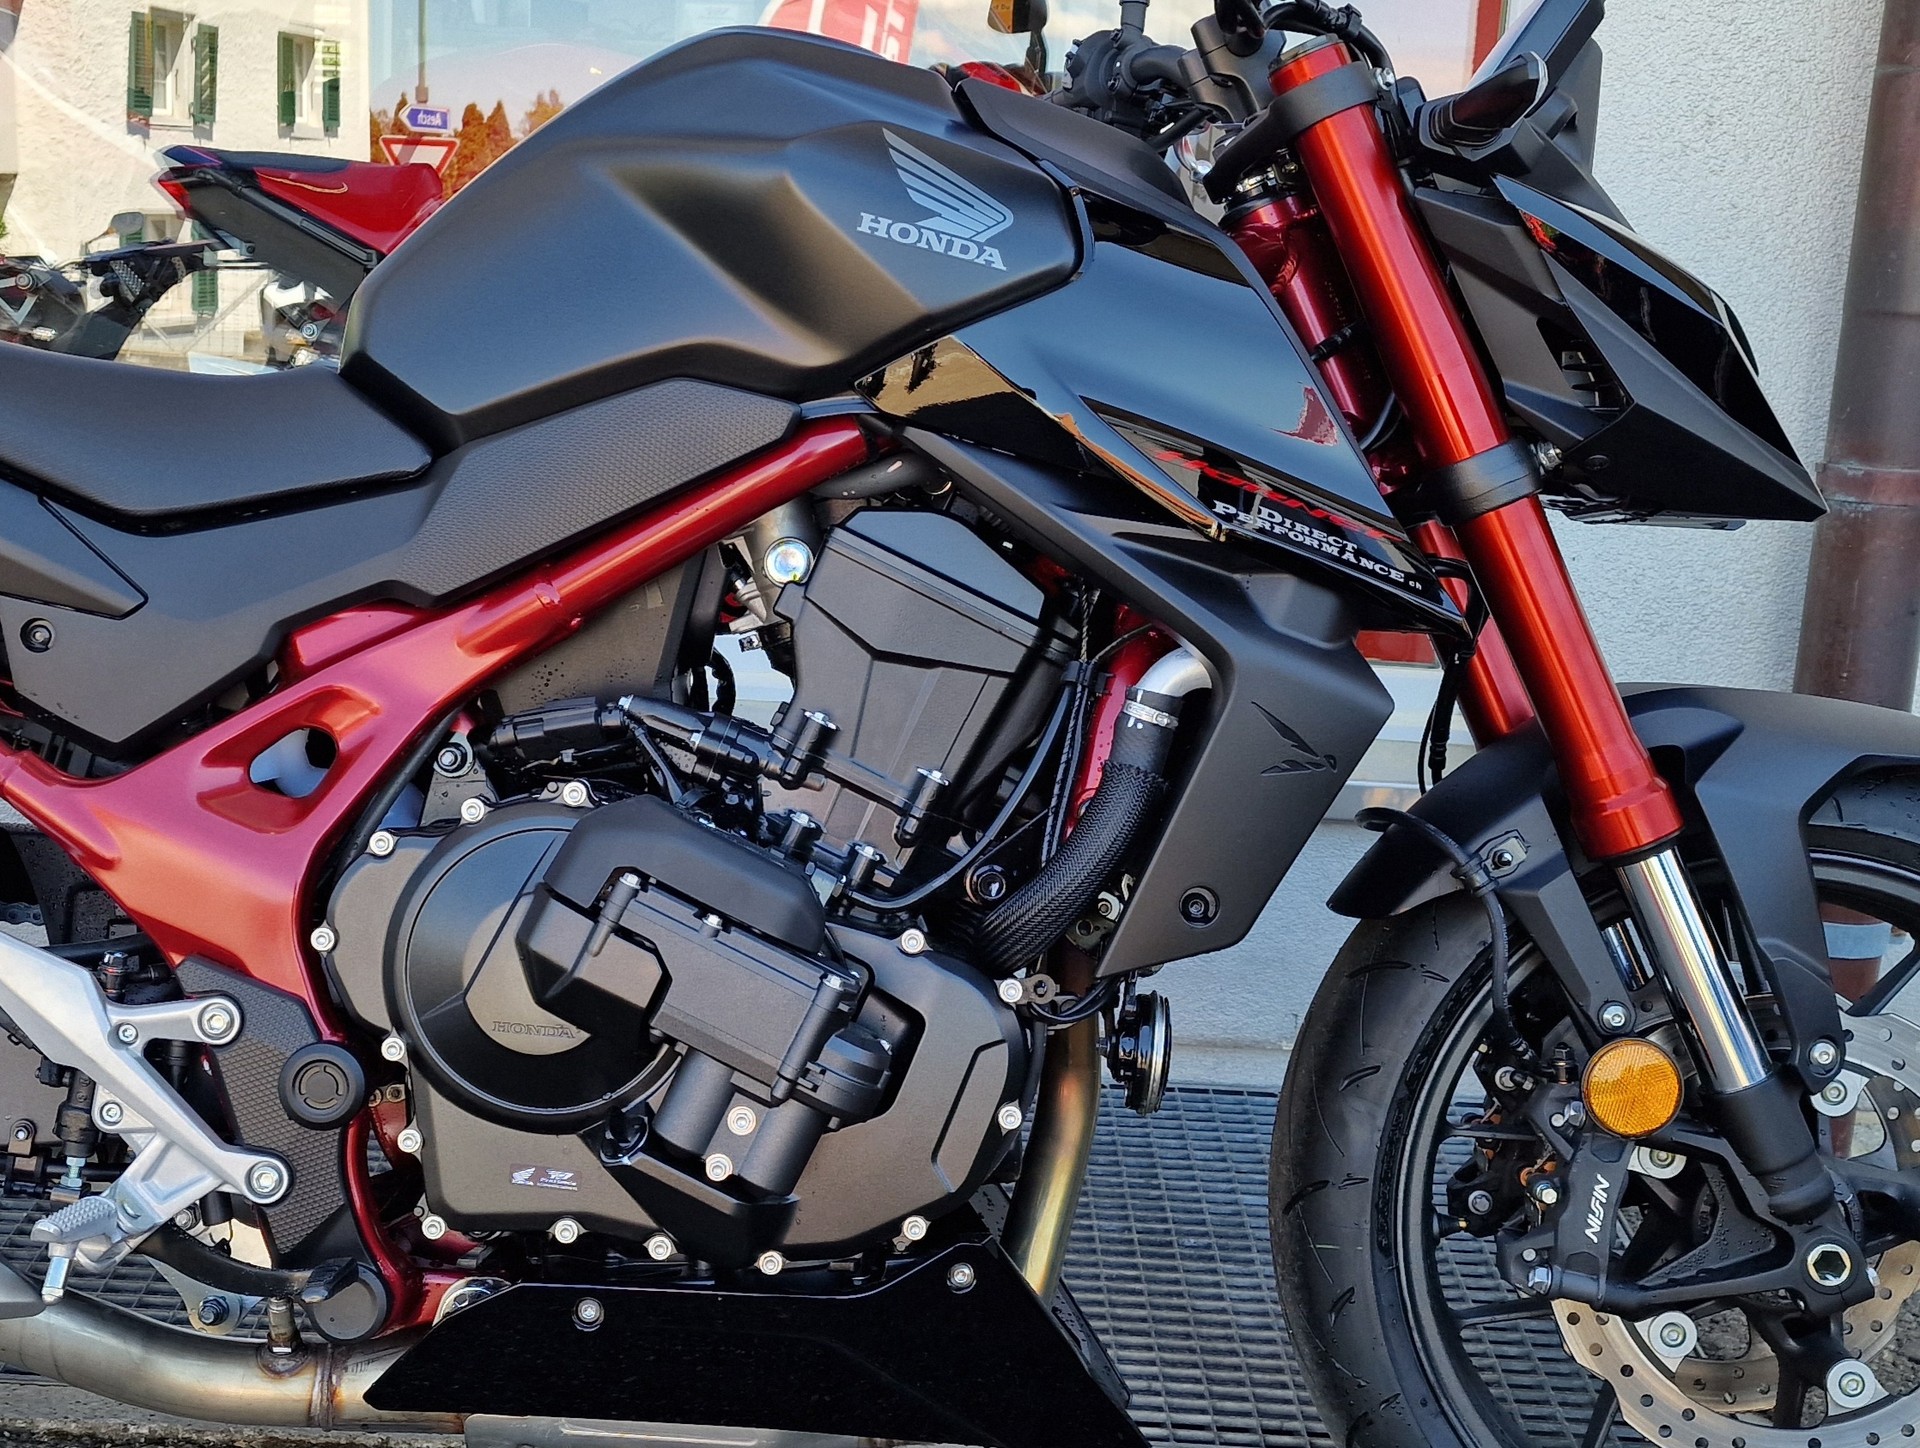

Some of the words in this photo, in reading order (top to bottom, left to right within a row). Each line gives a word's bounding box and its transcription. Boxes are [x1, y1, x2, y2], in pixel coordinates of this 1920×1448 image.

[856, 212, 1007, 271] HONDA
[1212, 499, 1405, 582] PERFORMANCE
[1257, 505, 1358, 553] DIRECT
[492, 1021, 576, 1039] HONDA
